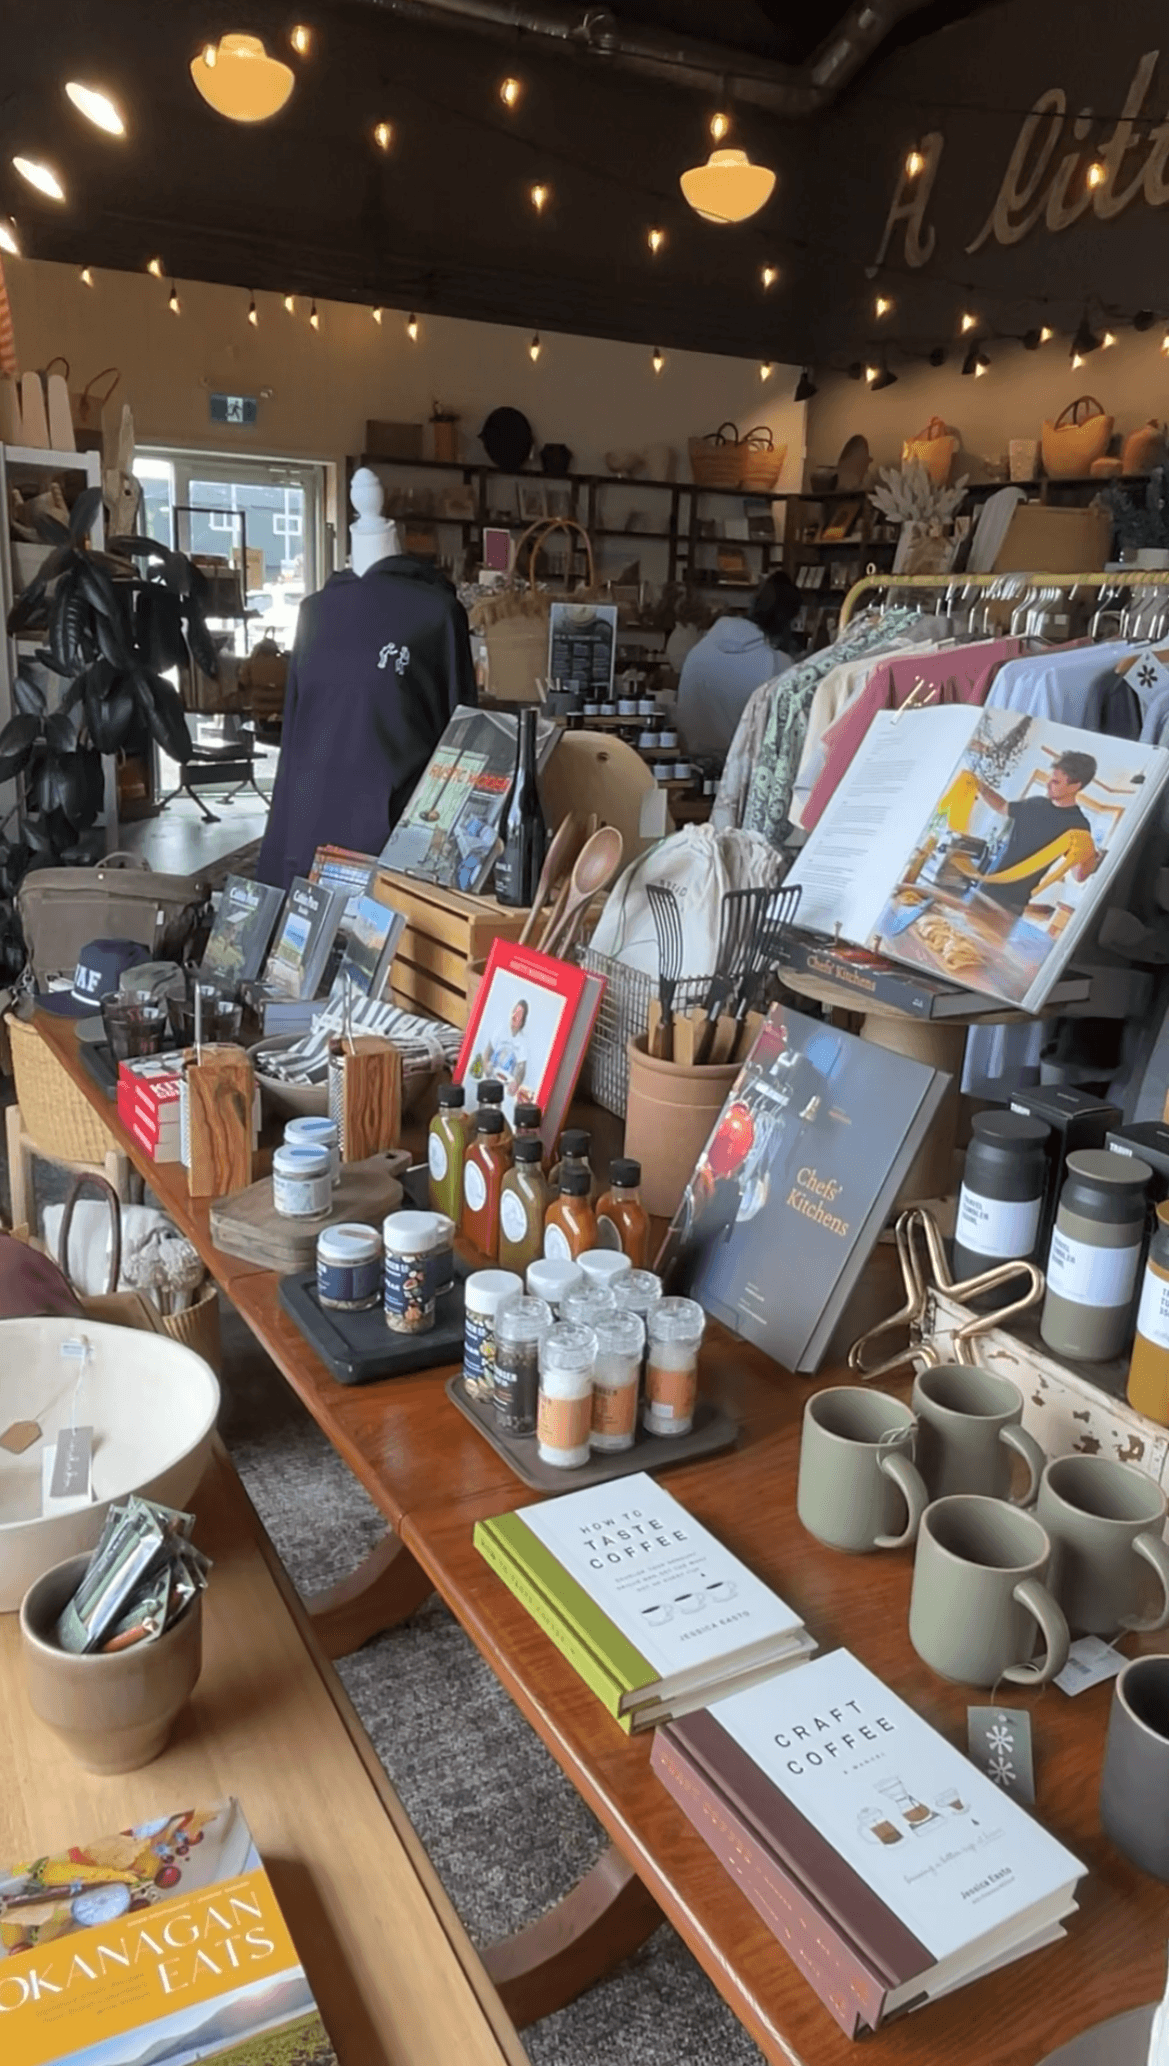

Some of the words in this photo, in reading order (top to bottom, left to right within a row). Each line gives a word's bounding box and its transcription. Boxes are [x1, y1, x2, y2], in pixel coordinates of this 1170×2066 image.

[864, 131, 945, 280] A
[796, 1166, 844, 1202] Chefs'
[786, 1186, 850, 1237] Kitchens
[580, 1518, 616, 1534] HOW
[622, 1509, 643, 1521] TO
[584, 1519, 664, 1551] TASTE
[589, 1530, 688, 1570] COFFEE
[774, 1700, 862, 1749] CRAFT
[786, 1716, 895, 1775] COFFEE
[0, 1891, 262, 2012] OKANAGAN
[158, 1926, 274, 1994] EATS
